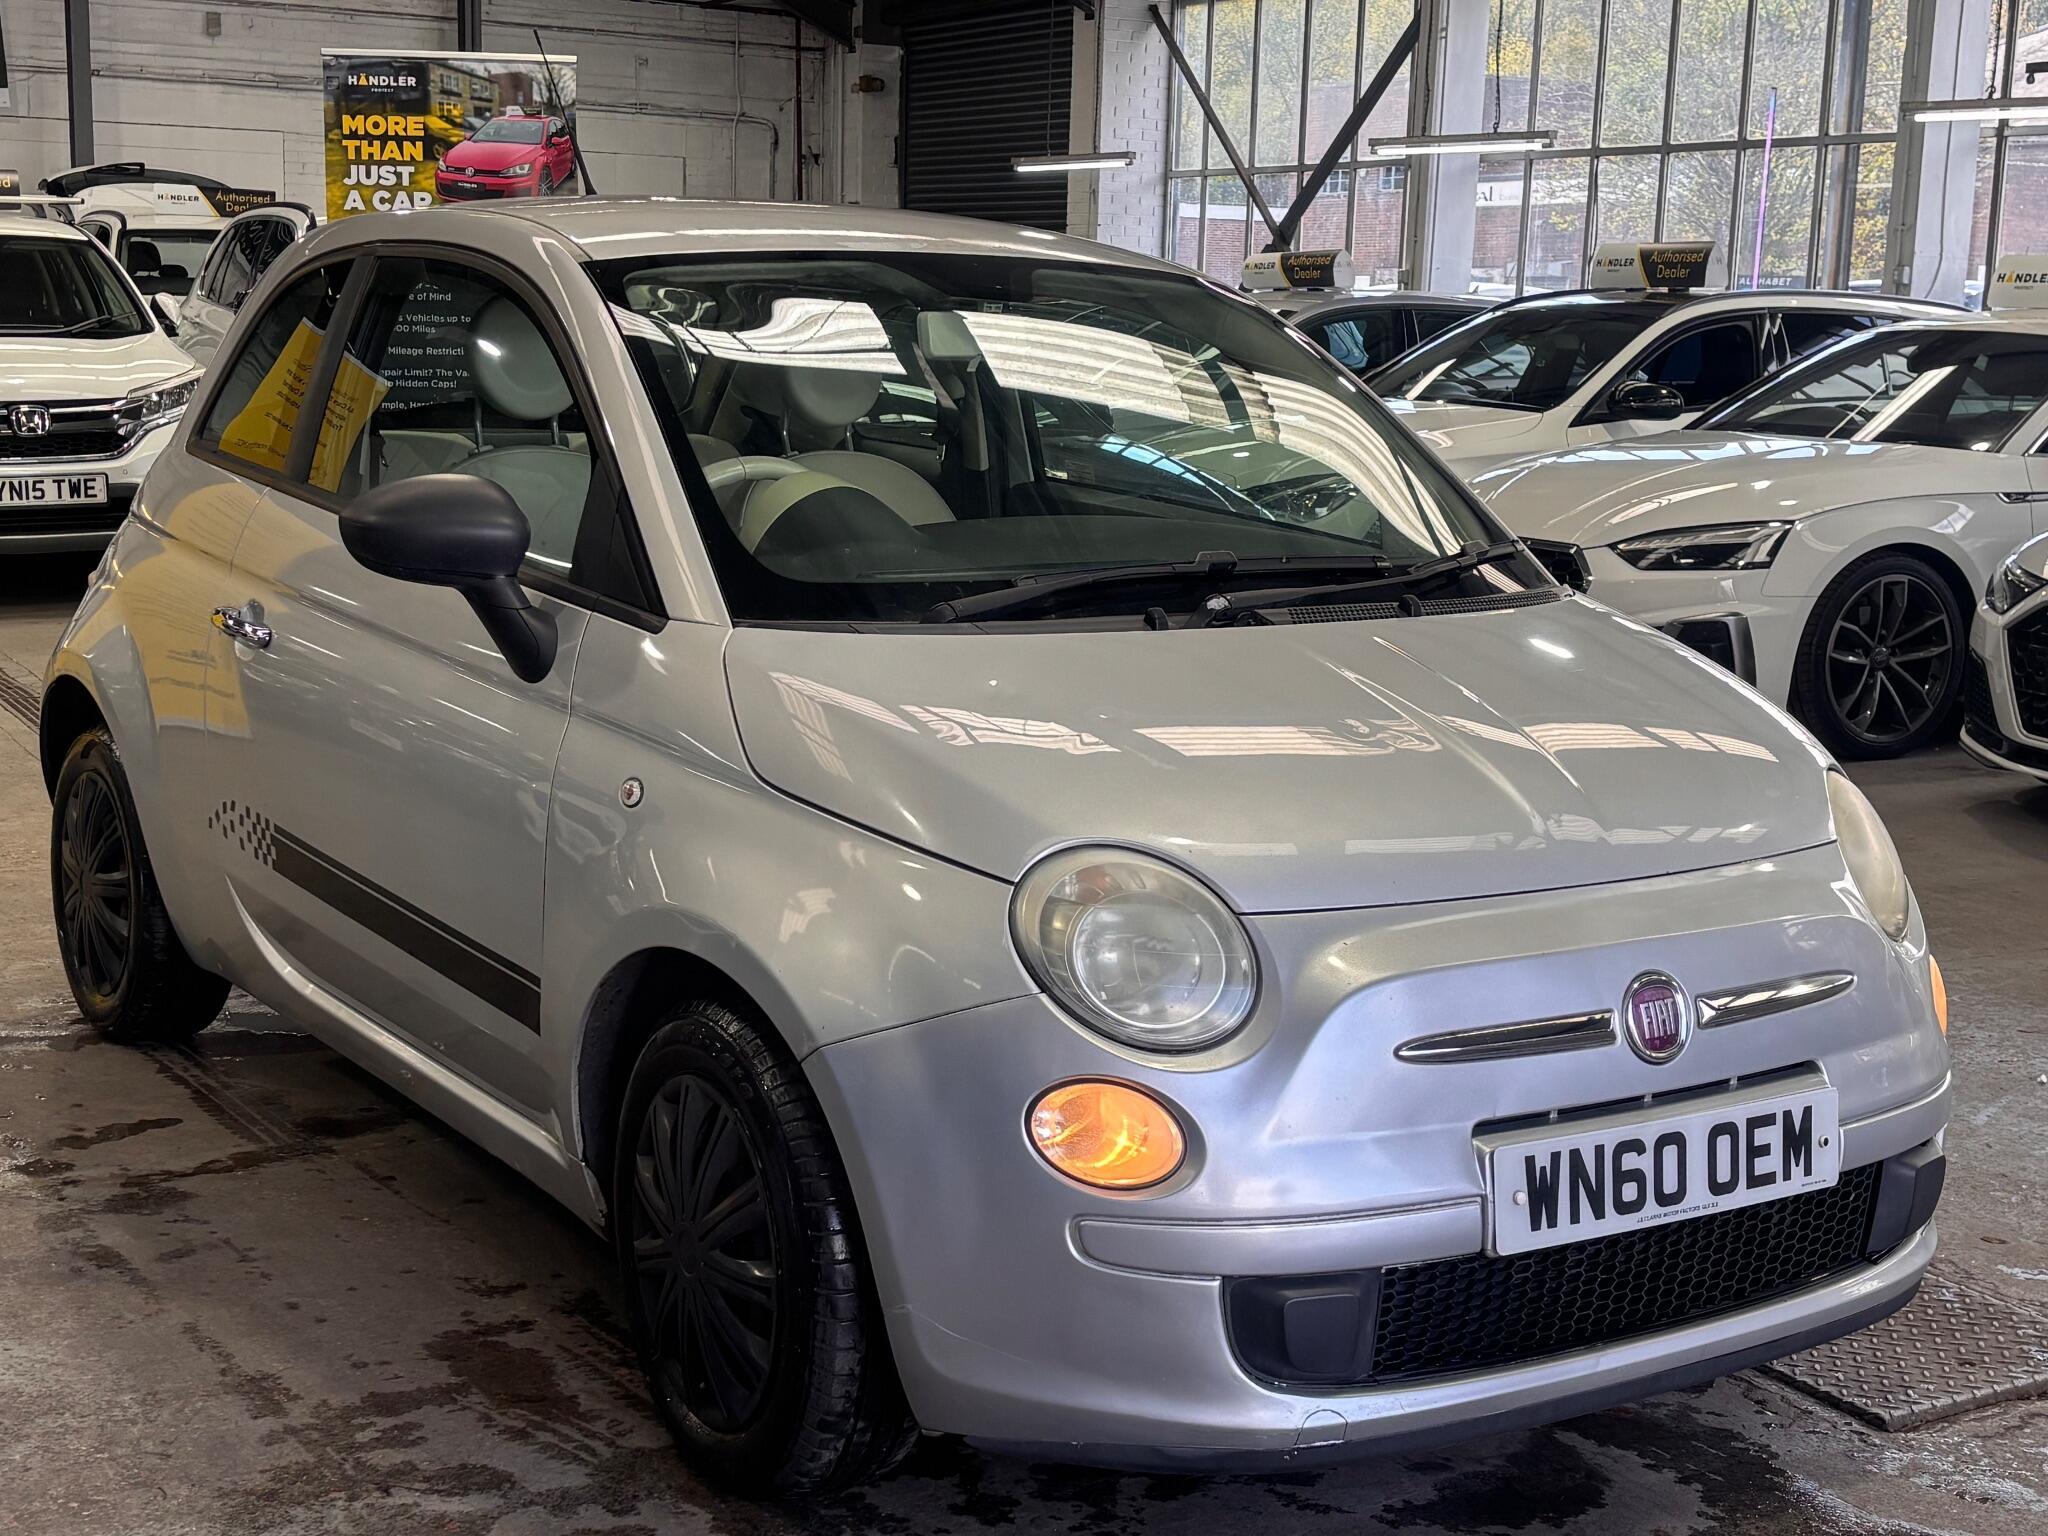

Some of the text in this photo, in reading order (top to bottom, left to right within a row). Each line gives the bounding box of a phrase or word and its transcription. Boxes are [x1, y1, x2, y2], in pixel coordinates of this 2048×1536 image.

[342, 115, 425, 137] MORE
[342, 140, 423, 161] THAN
[343, 165, 414, 186] JUST
[215, 189, 270, 204] Authorised
[344, 190, 432, 212] A CAR
[1287, 254, 1333, 266] Authorised
[1649, 249, 1707, 263] Authorised
[1294, 267, 1321, 279] Dealer
[1656, 264, 1691, 279] Dealer
[1738, 277, 1792, 286] ALHABET
[417, 292, 427, 301] of
[429, 292, 452, 301] Mind
[406, 314, 444, 323] Vehicles
[412, 325, 436, 333] Miles
[388, 346, 424, 357] Mileage
[404, 368, 433, 377] Limit?
[436, 368, 453, 377] The
[396, 379, 429, 388] Hidden
[431, 379, 457, 389] Caps!
[52, 477, 98, 500] TWE
[1639, 997, 1676, 1040] FIAT
[1524, 1105, 1813, 1232] WN60 OEM
